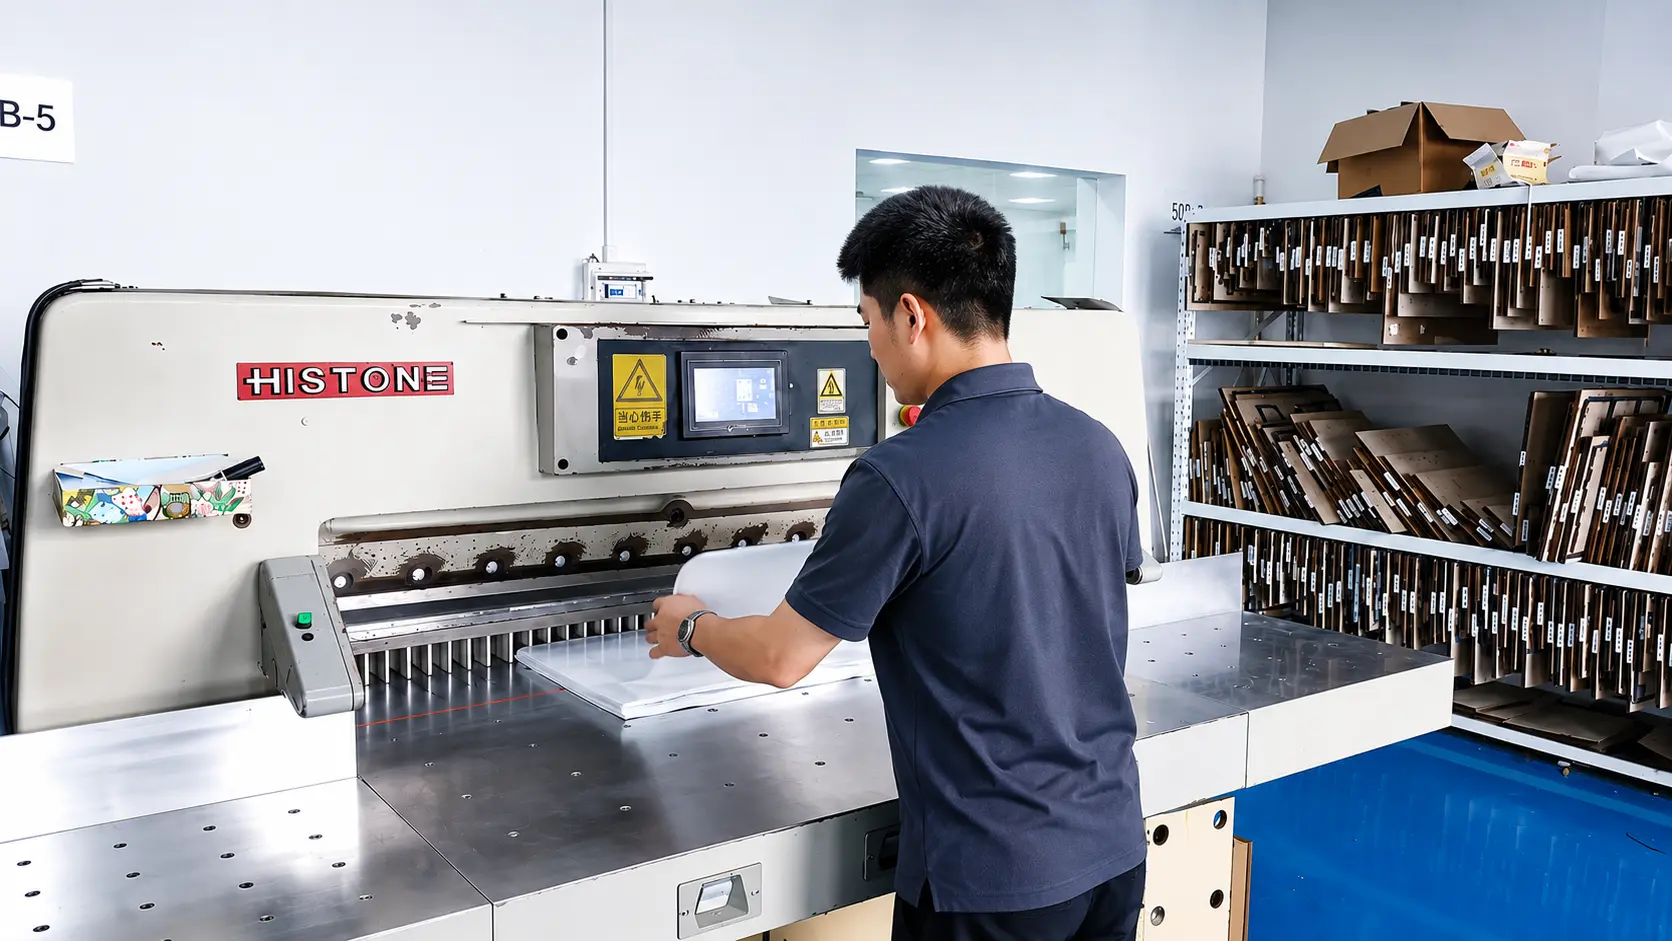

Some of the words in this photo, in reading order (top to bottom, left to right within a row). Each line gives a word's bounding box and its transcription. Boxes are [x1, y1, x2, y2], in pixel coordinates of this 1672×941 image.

[244, 366, 449, 395] HISTONE
[618, 411, 662, 424] 当心伤手
